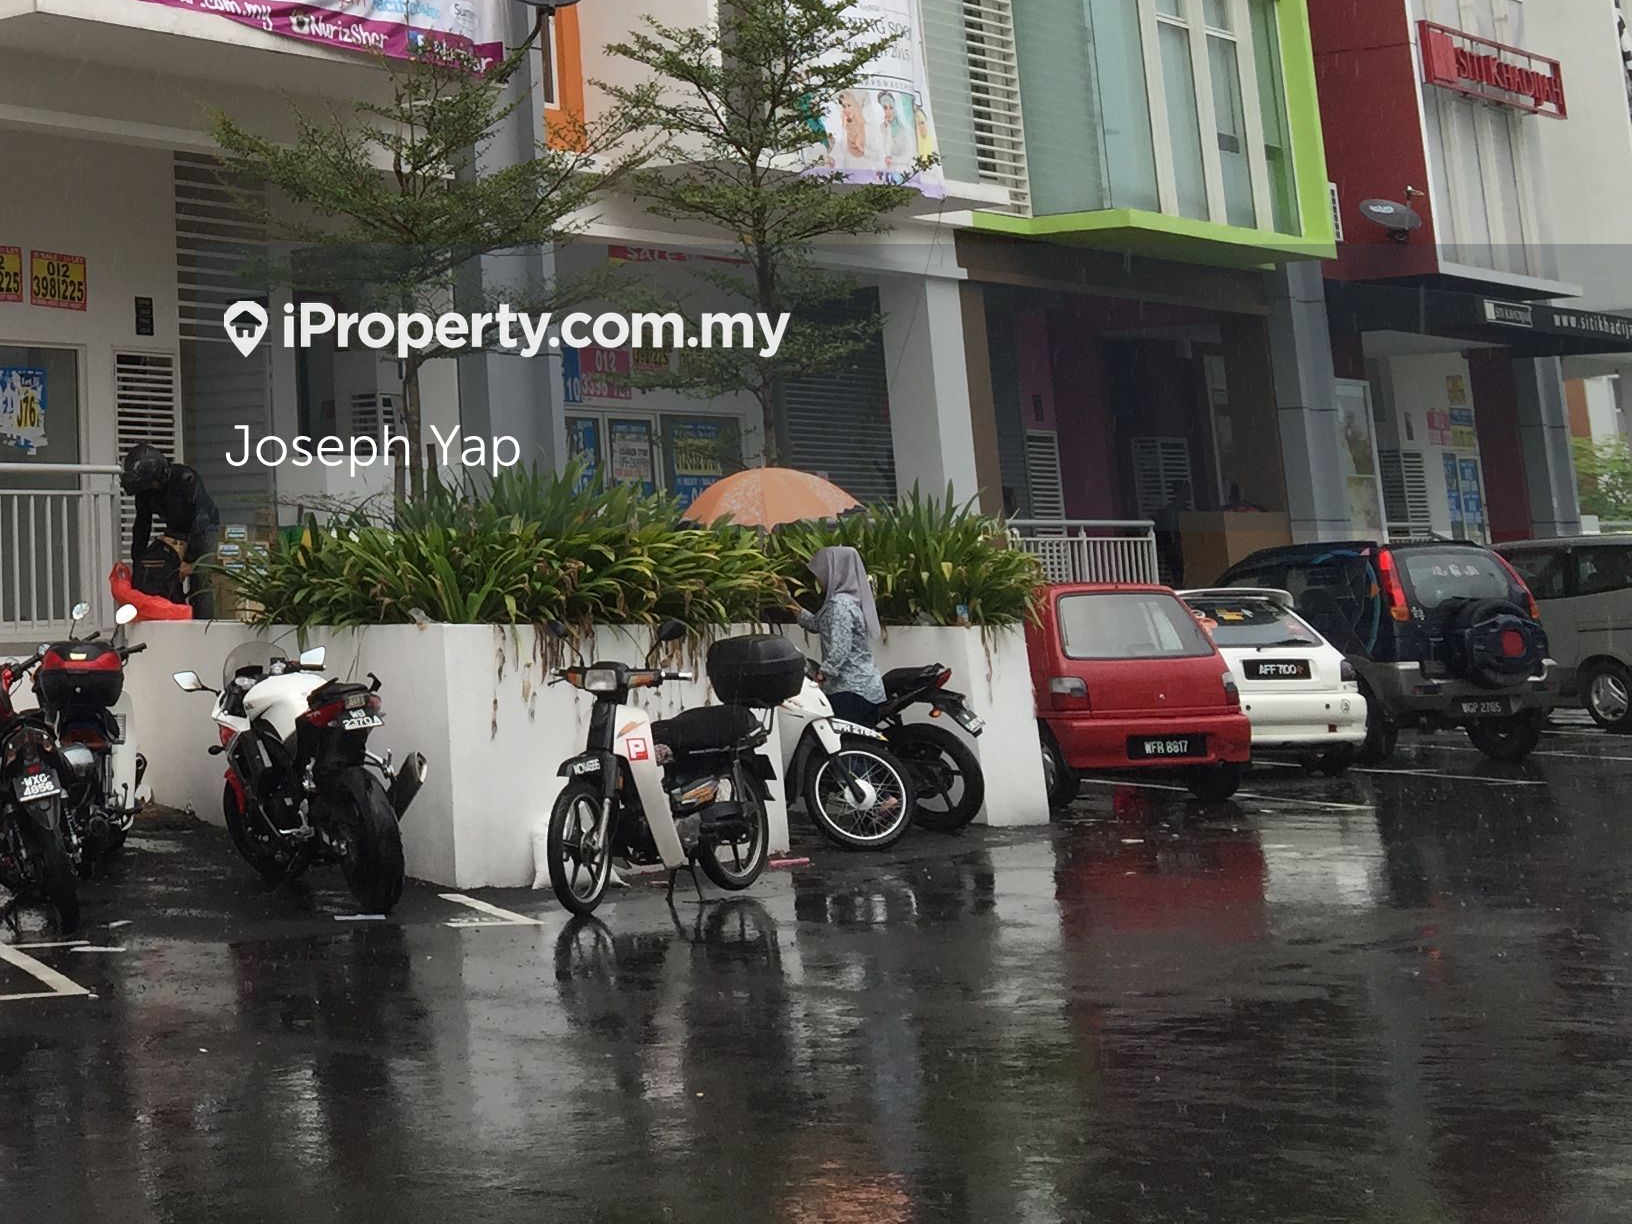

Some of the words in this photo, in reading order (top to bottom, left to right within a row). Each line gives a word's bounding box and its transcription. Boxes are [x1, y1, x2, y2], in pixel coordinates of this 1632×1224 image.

[47, 261, 71, 278] 012
[33, 274, 84, 302] 3981225
[1258, 663, 1277, 675] AFF
[628, 738, 646, 760] P
